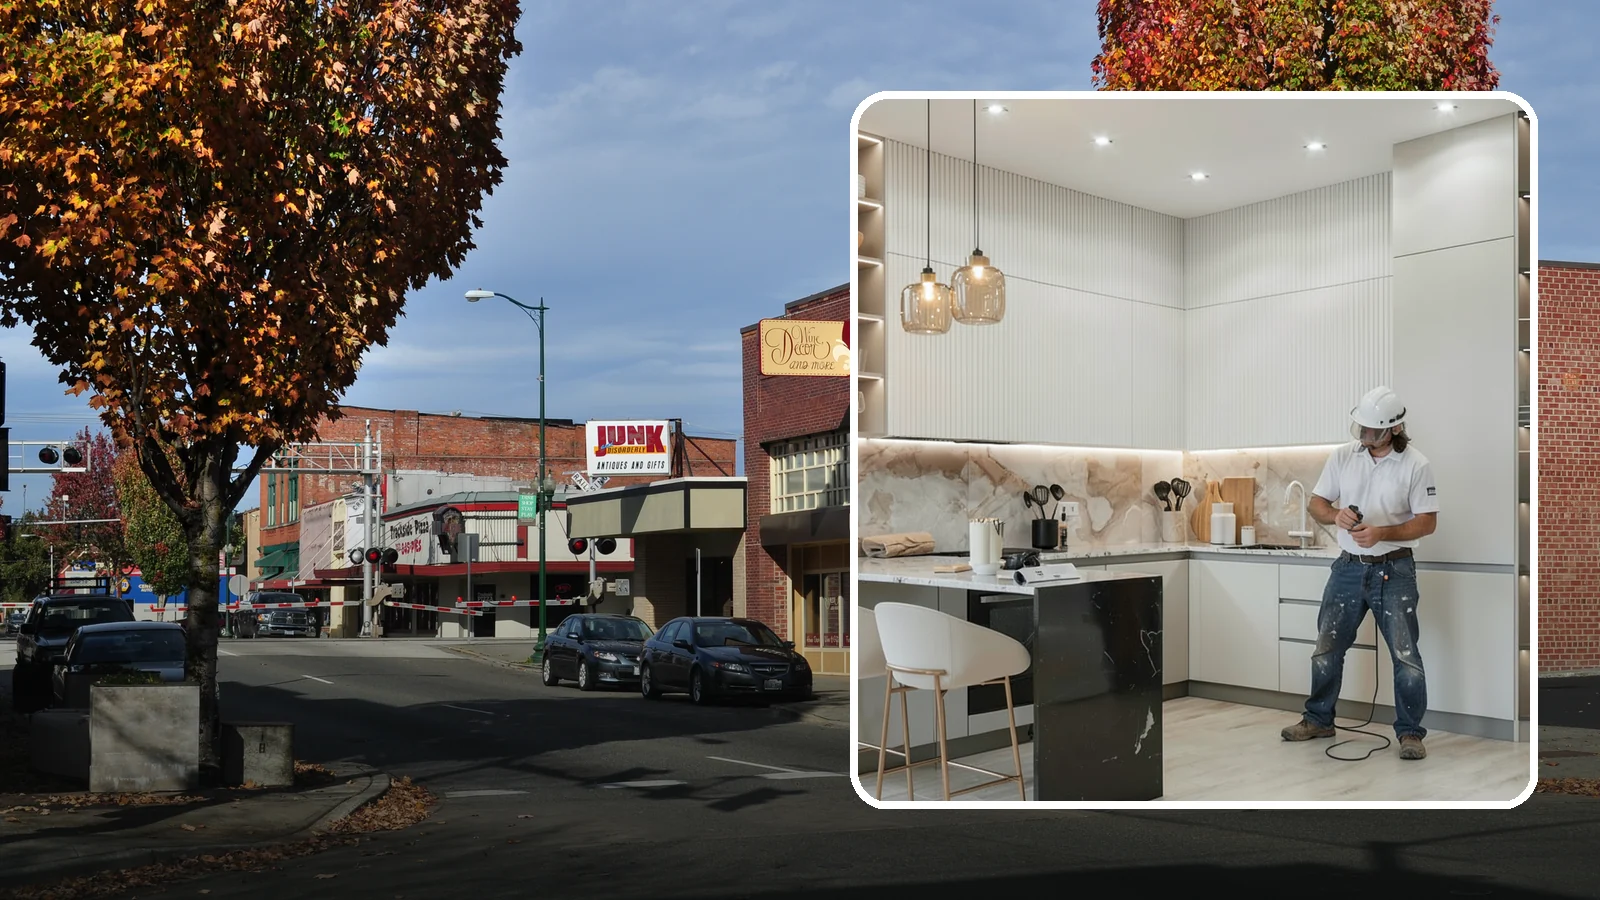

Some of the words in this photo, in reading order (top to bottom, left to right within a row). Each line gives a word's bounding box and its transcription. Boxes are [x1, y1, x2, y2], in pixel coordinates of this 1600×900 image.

[595, 424, 665, 457] JUNK
[607, 446, 645, 454] DISORDERLY
[596, 461, 628, 470] ANTIQUES
[631, 461, 644, 470] AND
[646, 460, 665, 470] GIFTS
[414, 519, 429, 535] Pizza
